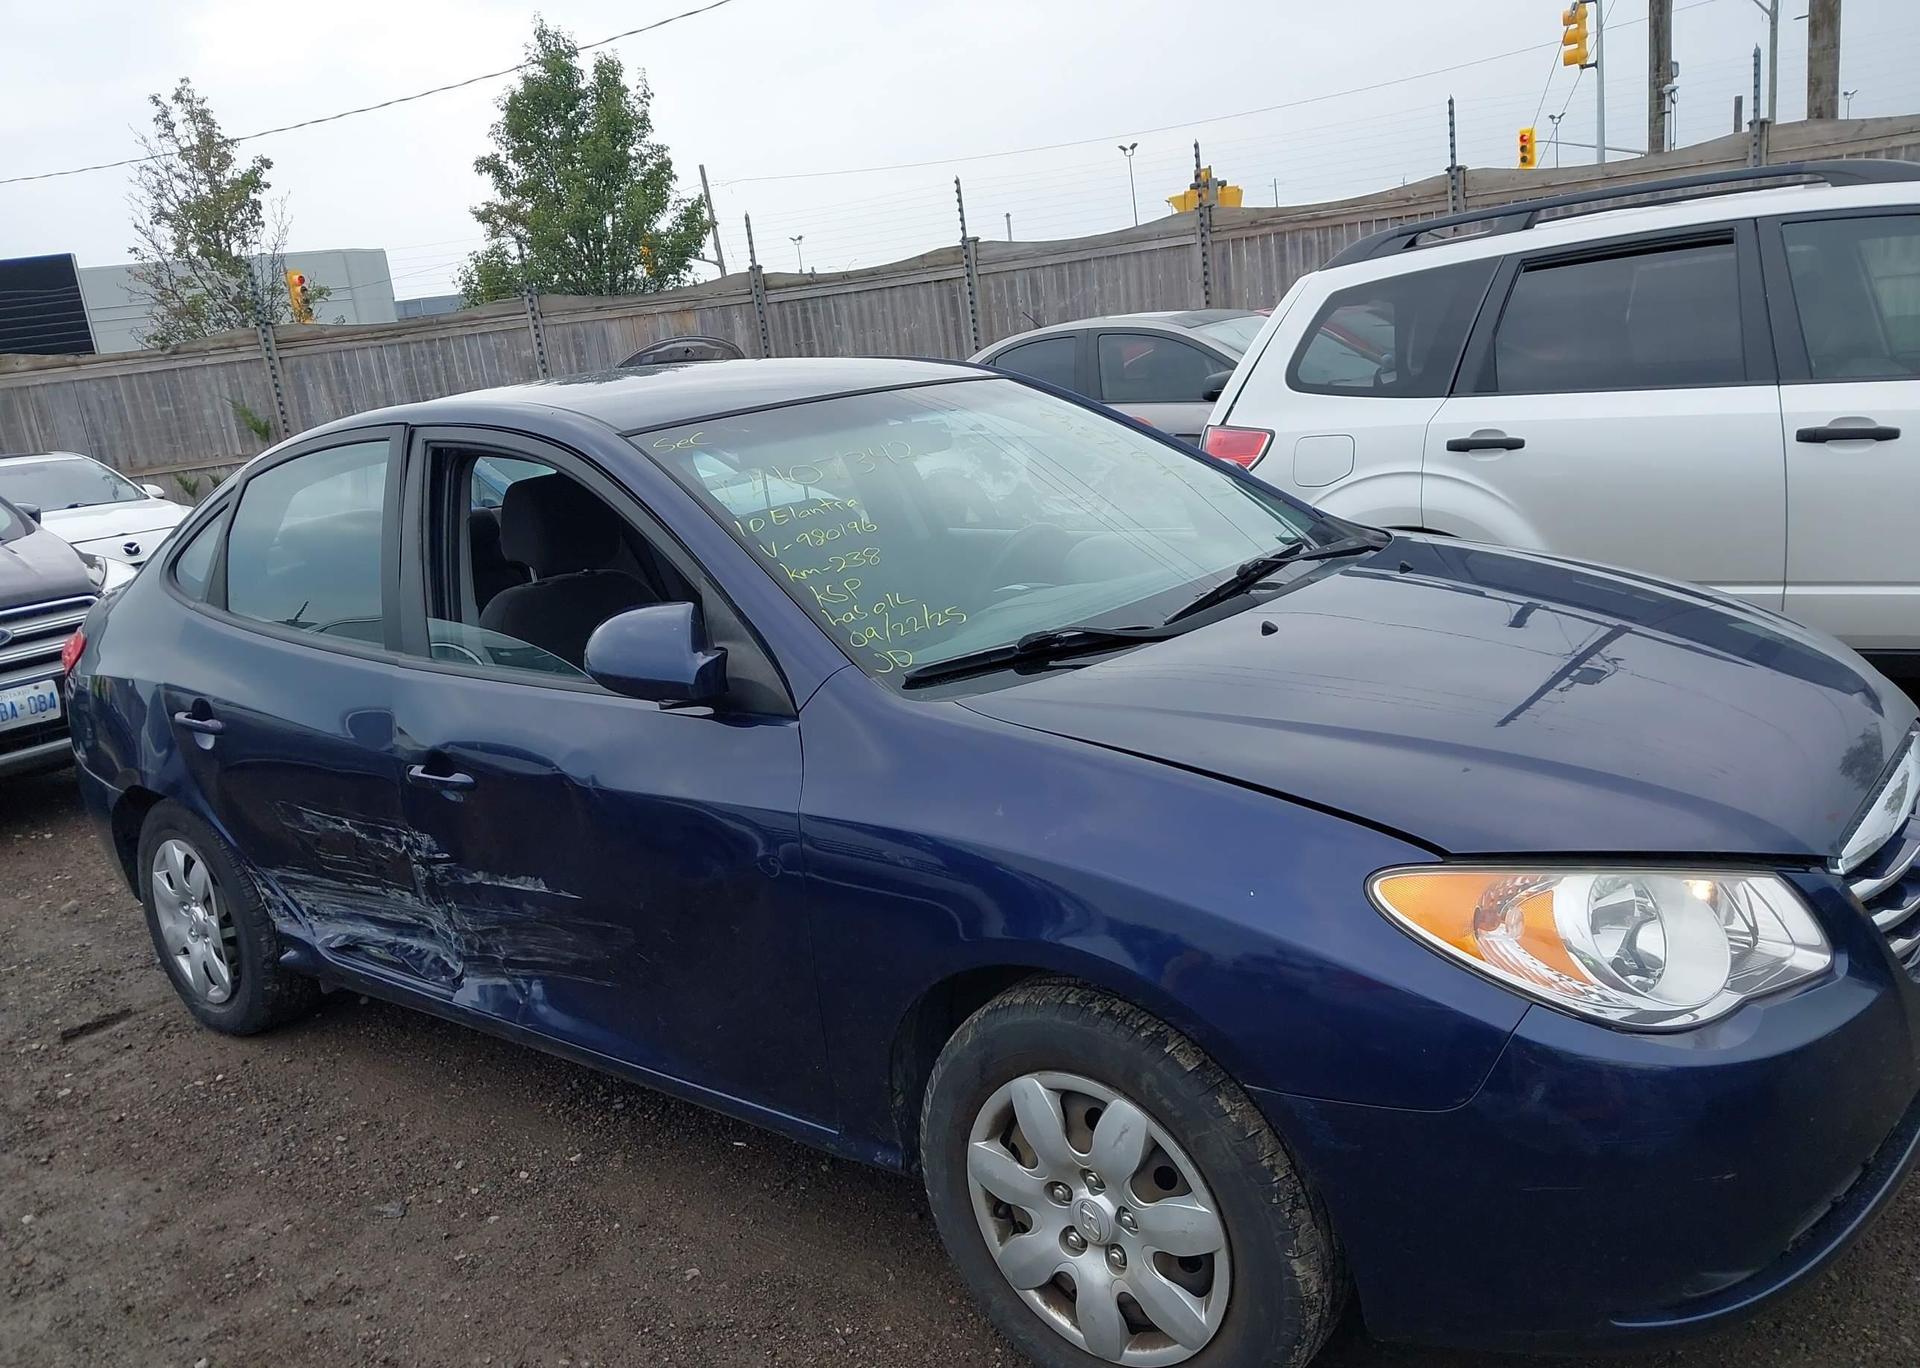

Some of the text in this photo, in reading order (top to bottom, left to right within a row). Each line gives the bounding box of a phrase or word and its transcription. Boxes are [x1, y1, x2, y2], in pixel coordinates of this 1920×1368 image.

[734, 497, 859, 537] 10 Elantra
[850, 604, 967, 647] 09/22/25
